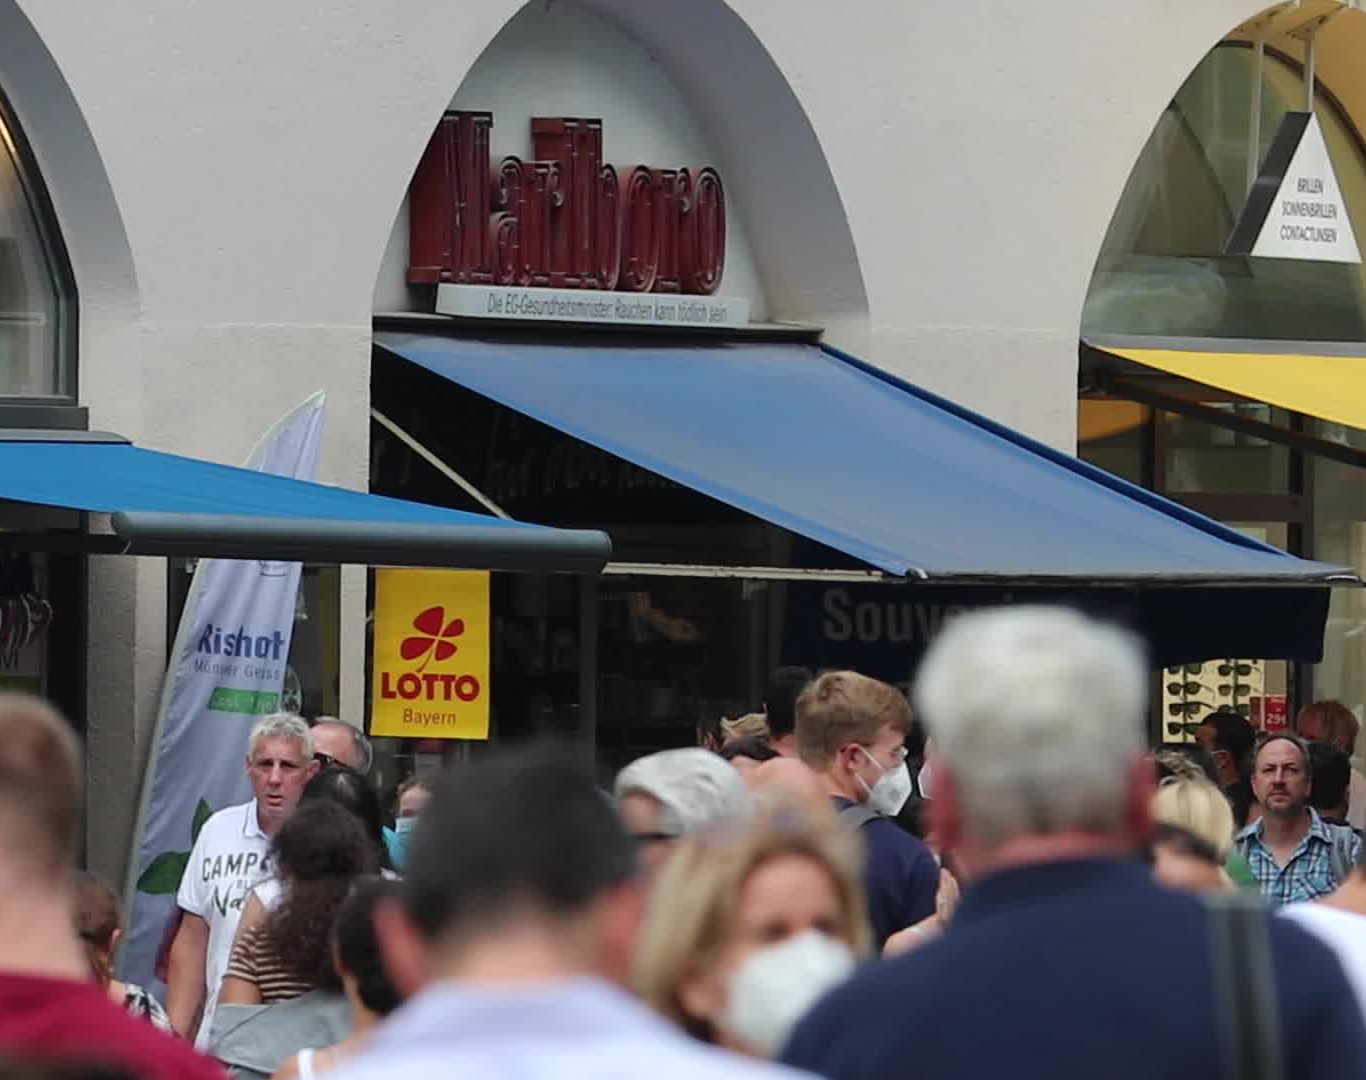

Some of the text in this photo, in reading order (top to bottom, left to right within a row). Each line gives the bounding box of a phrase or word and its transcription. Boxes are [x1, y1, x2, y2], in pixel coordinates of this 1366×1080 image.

[1297, 178, 1323, 194] BRILLEN
[407, 110, 727, 294] Marlboro
[1282, 201, 1338, 219] SONNENBRILLEN
[1280, 224, 1338, 243] CONTACTLINSEN
[380, 671, 481, 702] LOTTO
[402, 708, 457, 727] Bayern
[201, 852, 259, 881] CAMP
